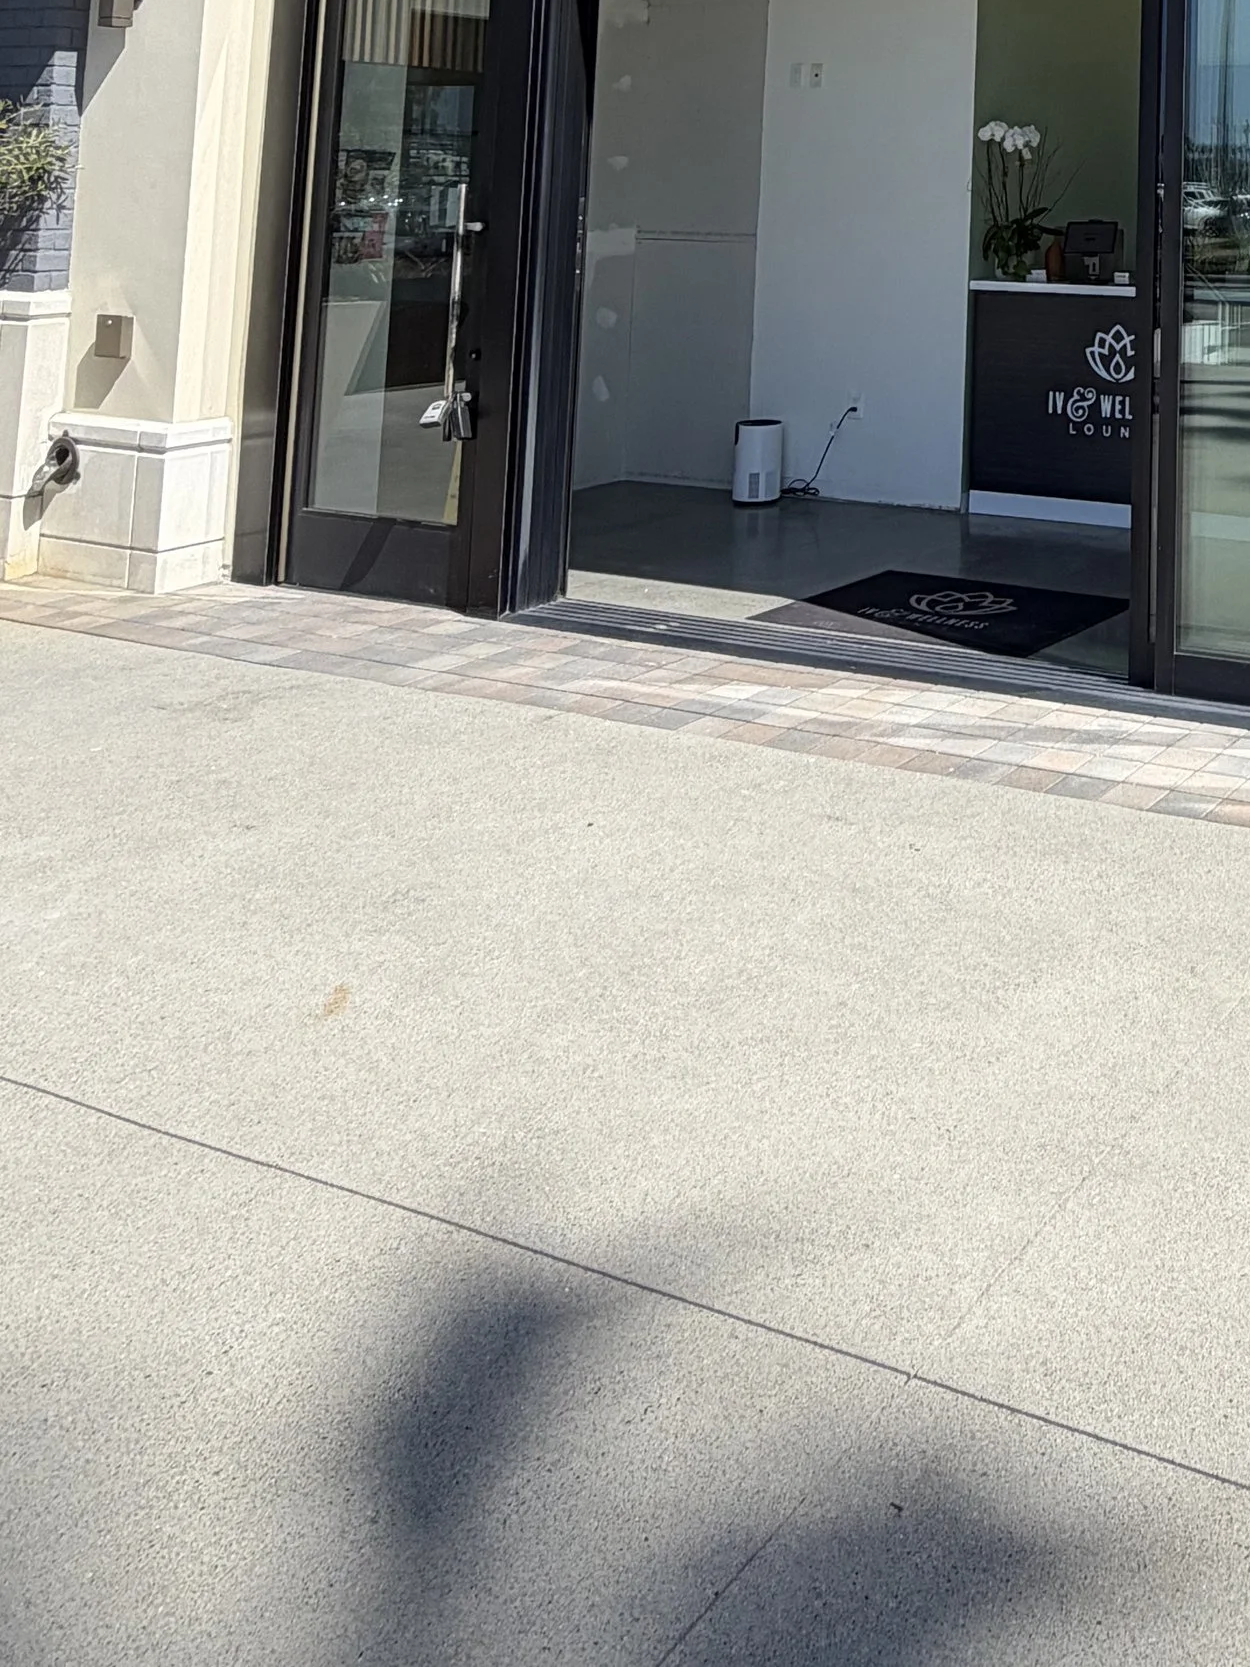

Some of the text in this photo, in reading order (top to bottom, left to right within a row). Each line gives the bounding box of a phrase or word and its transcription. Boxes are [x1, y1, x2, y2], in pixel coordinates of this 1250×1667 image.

[1048, 387, 1133, 422] IV & WEL
[1069, 423, 1130, 438] LOUN
